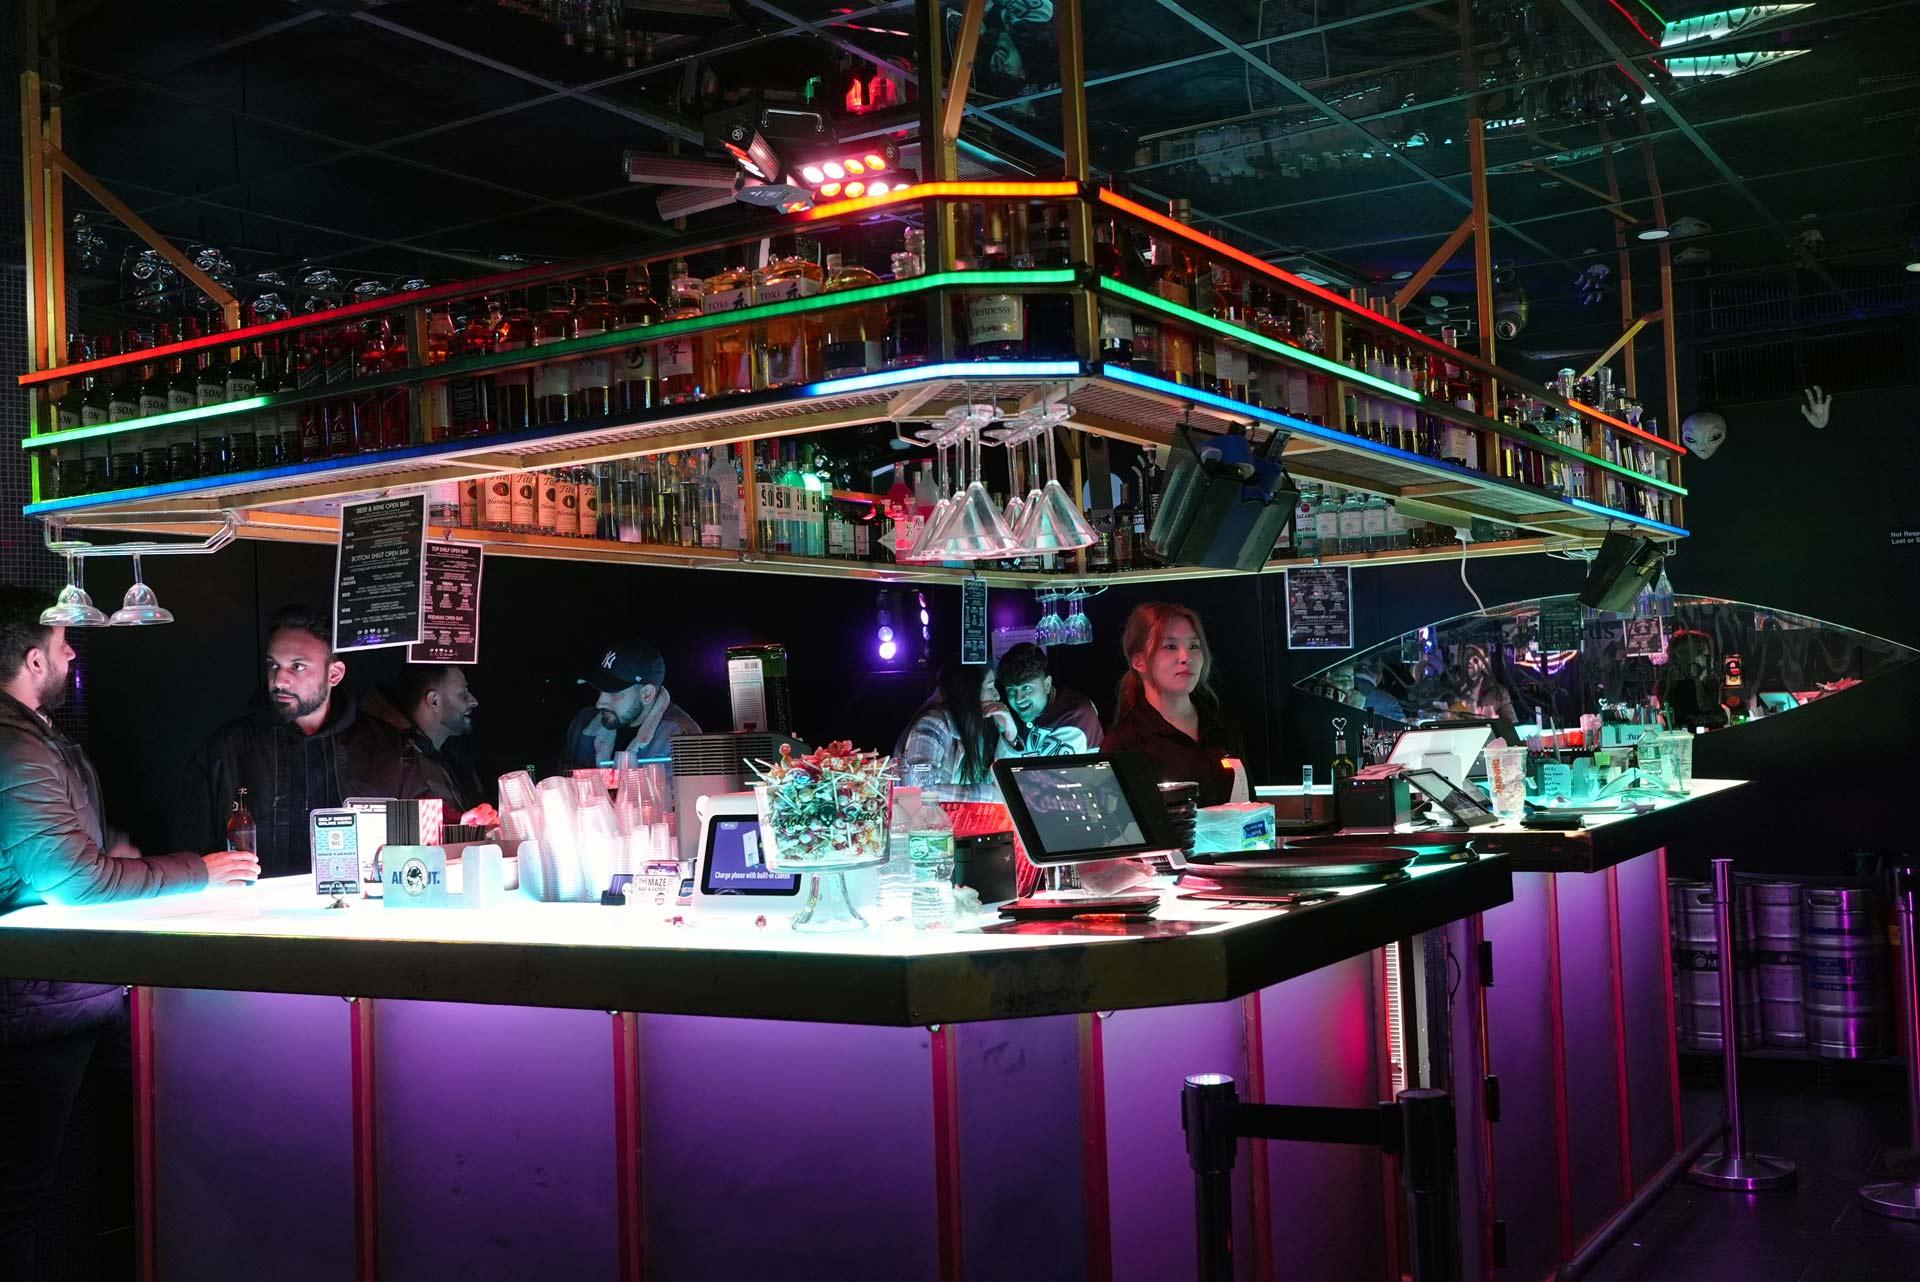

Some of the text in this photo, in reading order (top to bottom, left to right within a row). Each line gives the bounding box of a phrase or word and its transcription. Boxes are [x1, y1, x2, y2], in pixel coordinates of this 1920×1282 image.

[760, 291, 781, 300] TOKI
[708, 301, 728, 310] TOKI
[715, 871, 731, 880] Charge
[731, 871, 745, 880] phone
[746, 871, 756, 879] with
[648, 878, 667, 886] MAZE
